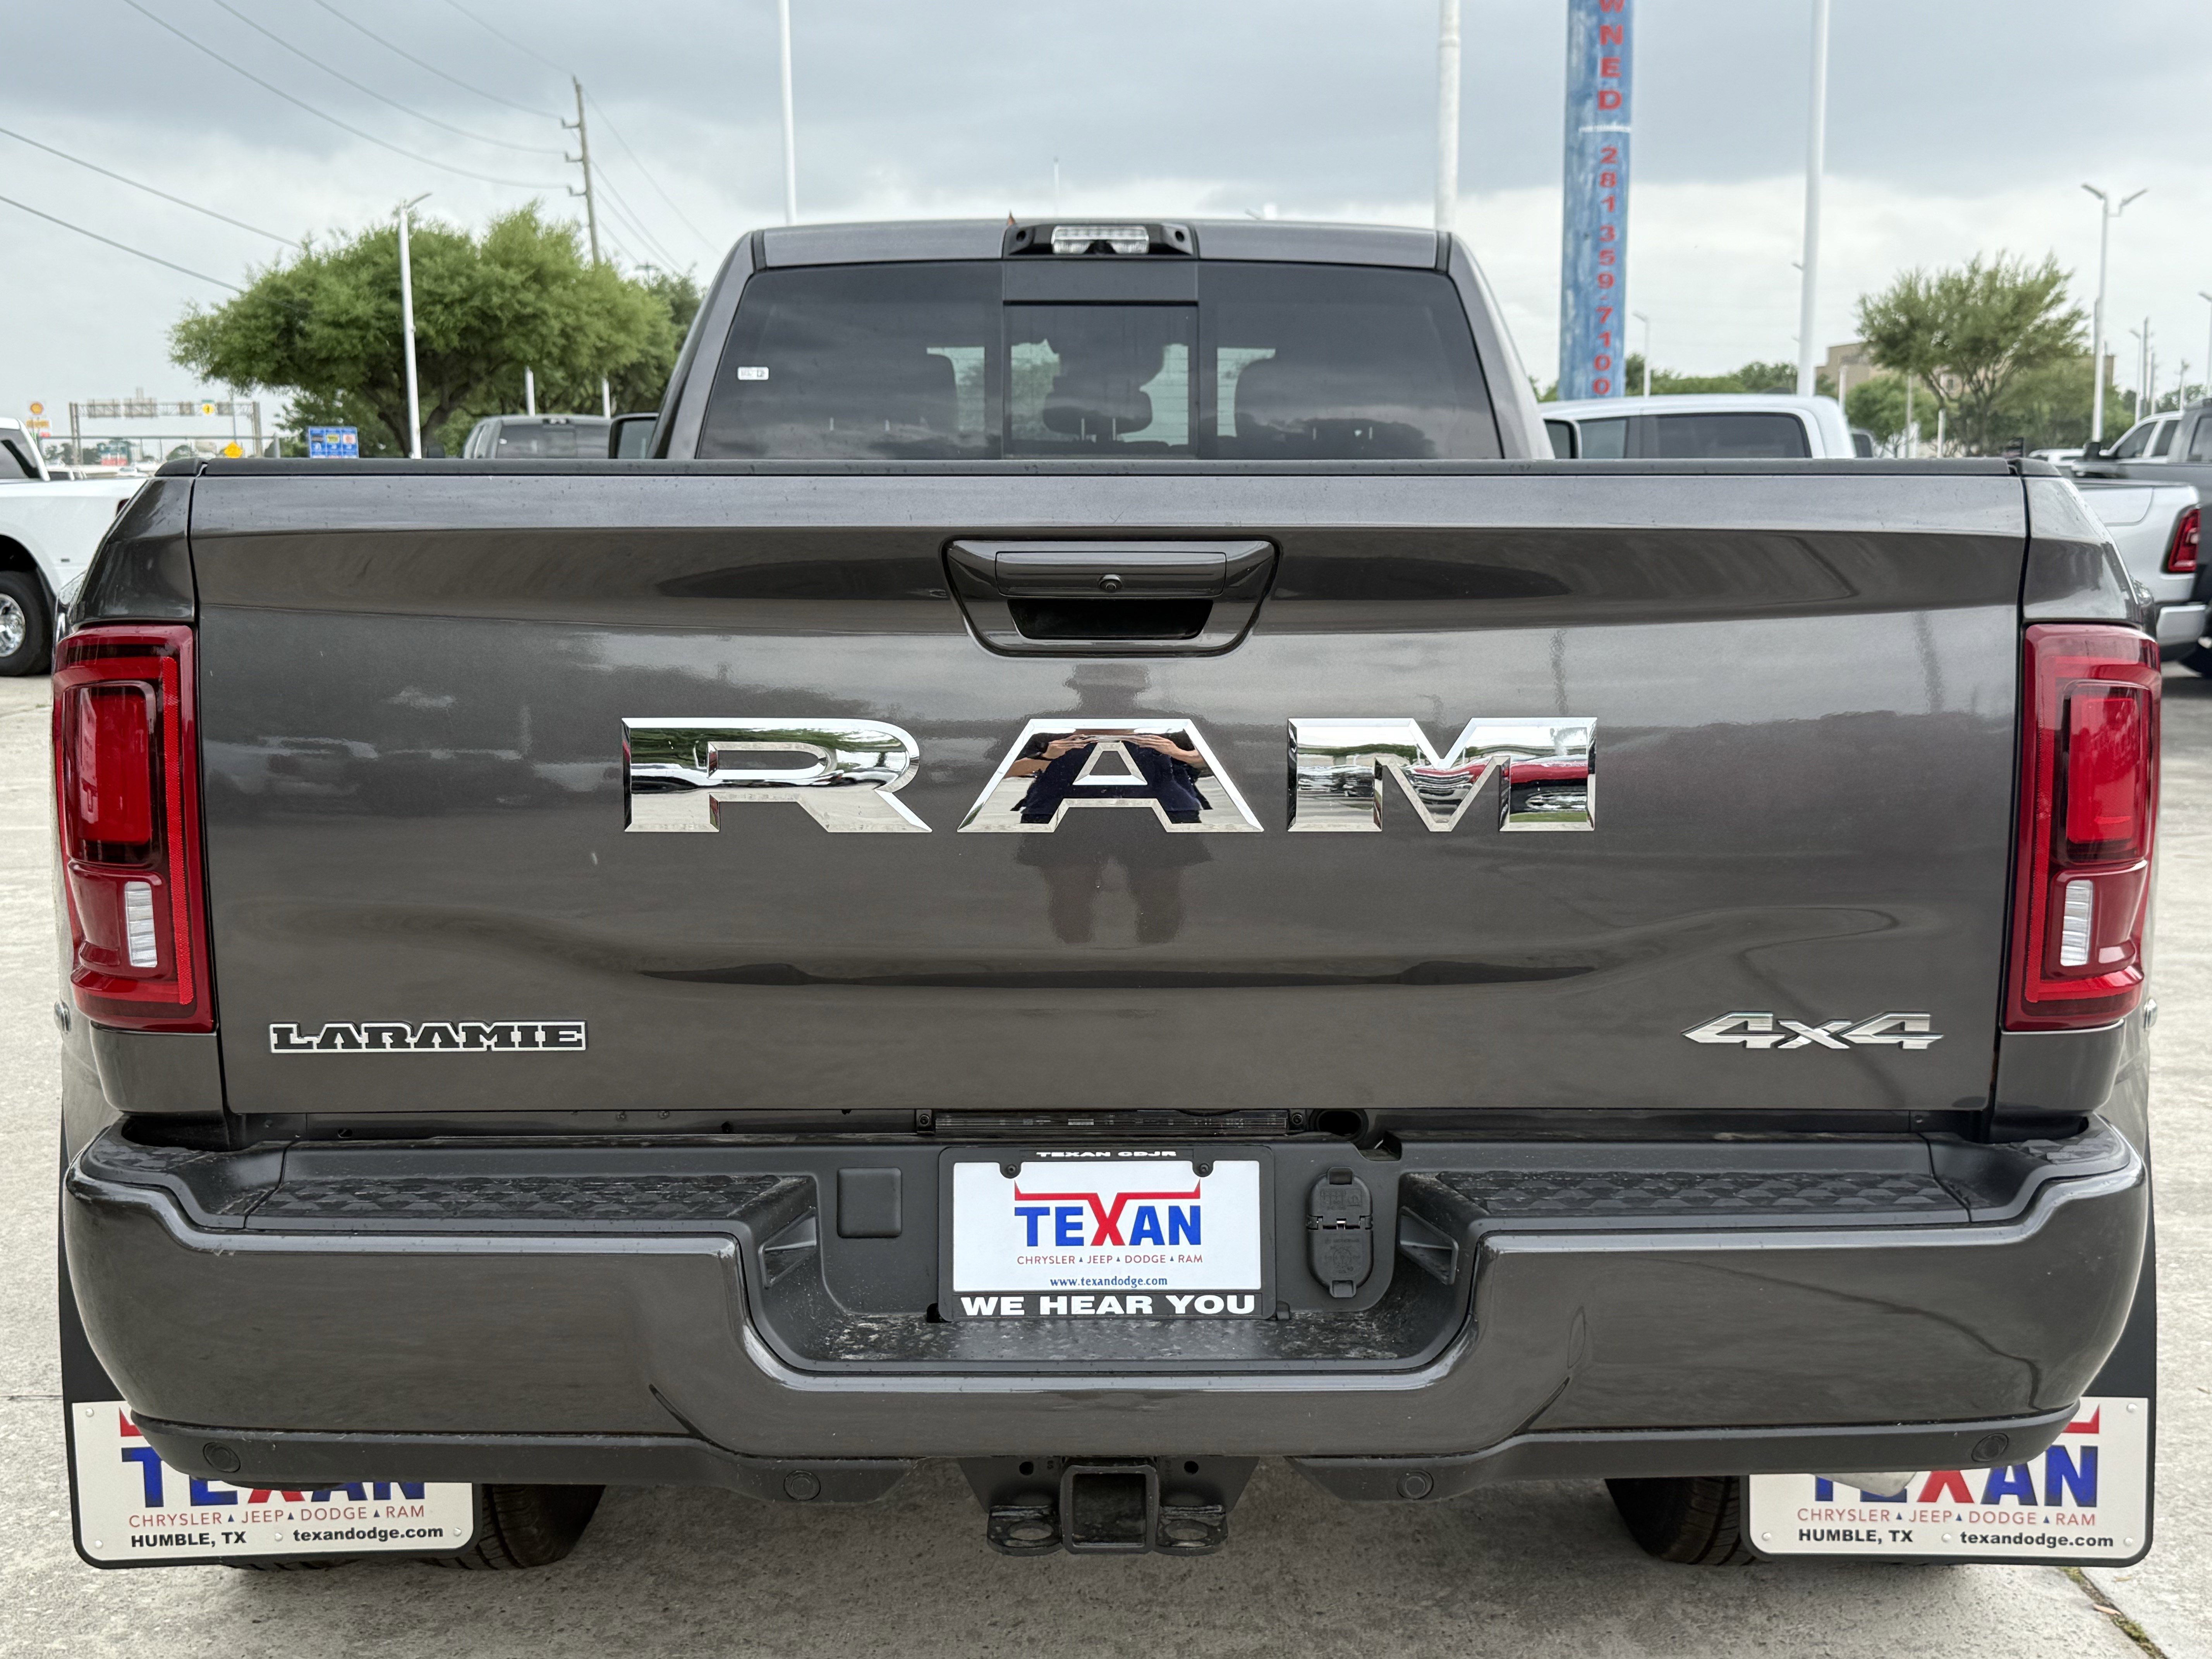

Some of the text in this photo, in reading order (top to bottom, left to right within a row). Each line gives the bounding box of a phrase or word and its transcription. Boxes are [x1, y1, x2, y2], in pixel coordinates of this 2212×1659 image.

[1599, 0, 1624, 110] WNED
[622, 717, 1598, 833] RAM
[270, 1021, 587, 1053] LARAMIE
[1015, 1194, 1201, 1247] TEXAN
[1017, 1254, 1203, 1265] CHRYSLER JEEP DODGE RAM
[1050, 1276, 1168, 1289] www.texandodge.com
[961, 1294, 1255, 1316] WE HEAR YOU
[129, 1505, 424, 1528] CHRYSLER JEEP DODGE RAM
[1797, 1508, 2095, 1526] CHRYSLER JEEP DODGE RAM
[131, 1531, 247, 1547] HUMBLE, TX
[293, 1527, 443, 1542] texandodge.com
[1799, 1528, 1913, 1544] HUMBLE, TX
[1960, 1531, 2113, 1548] texandodge.com
